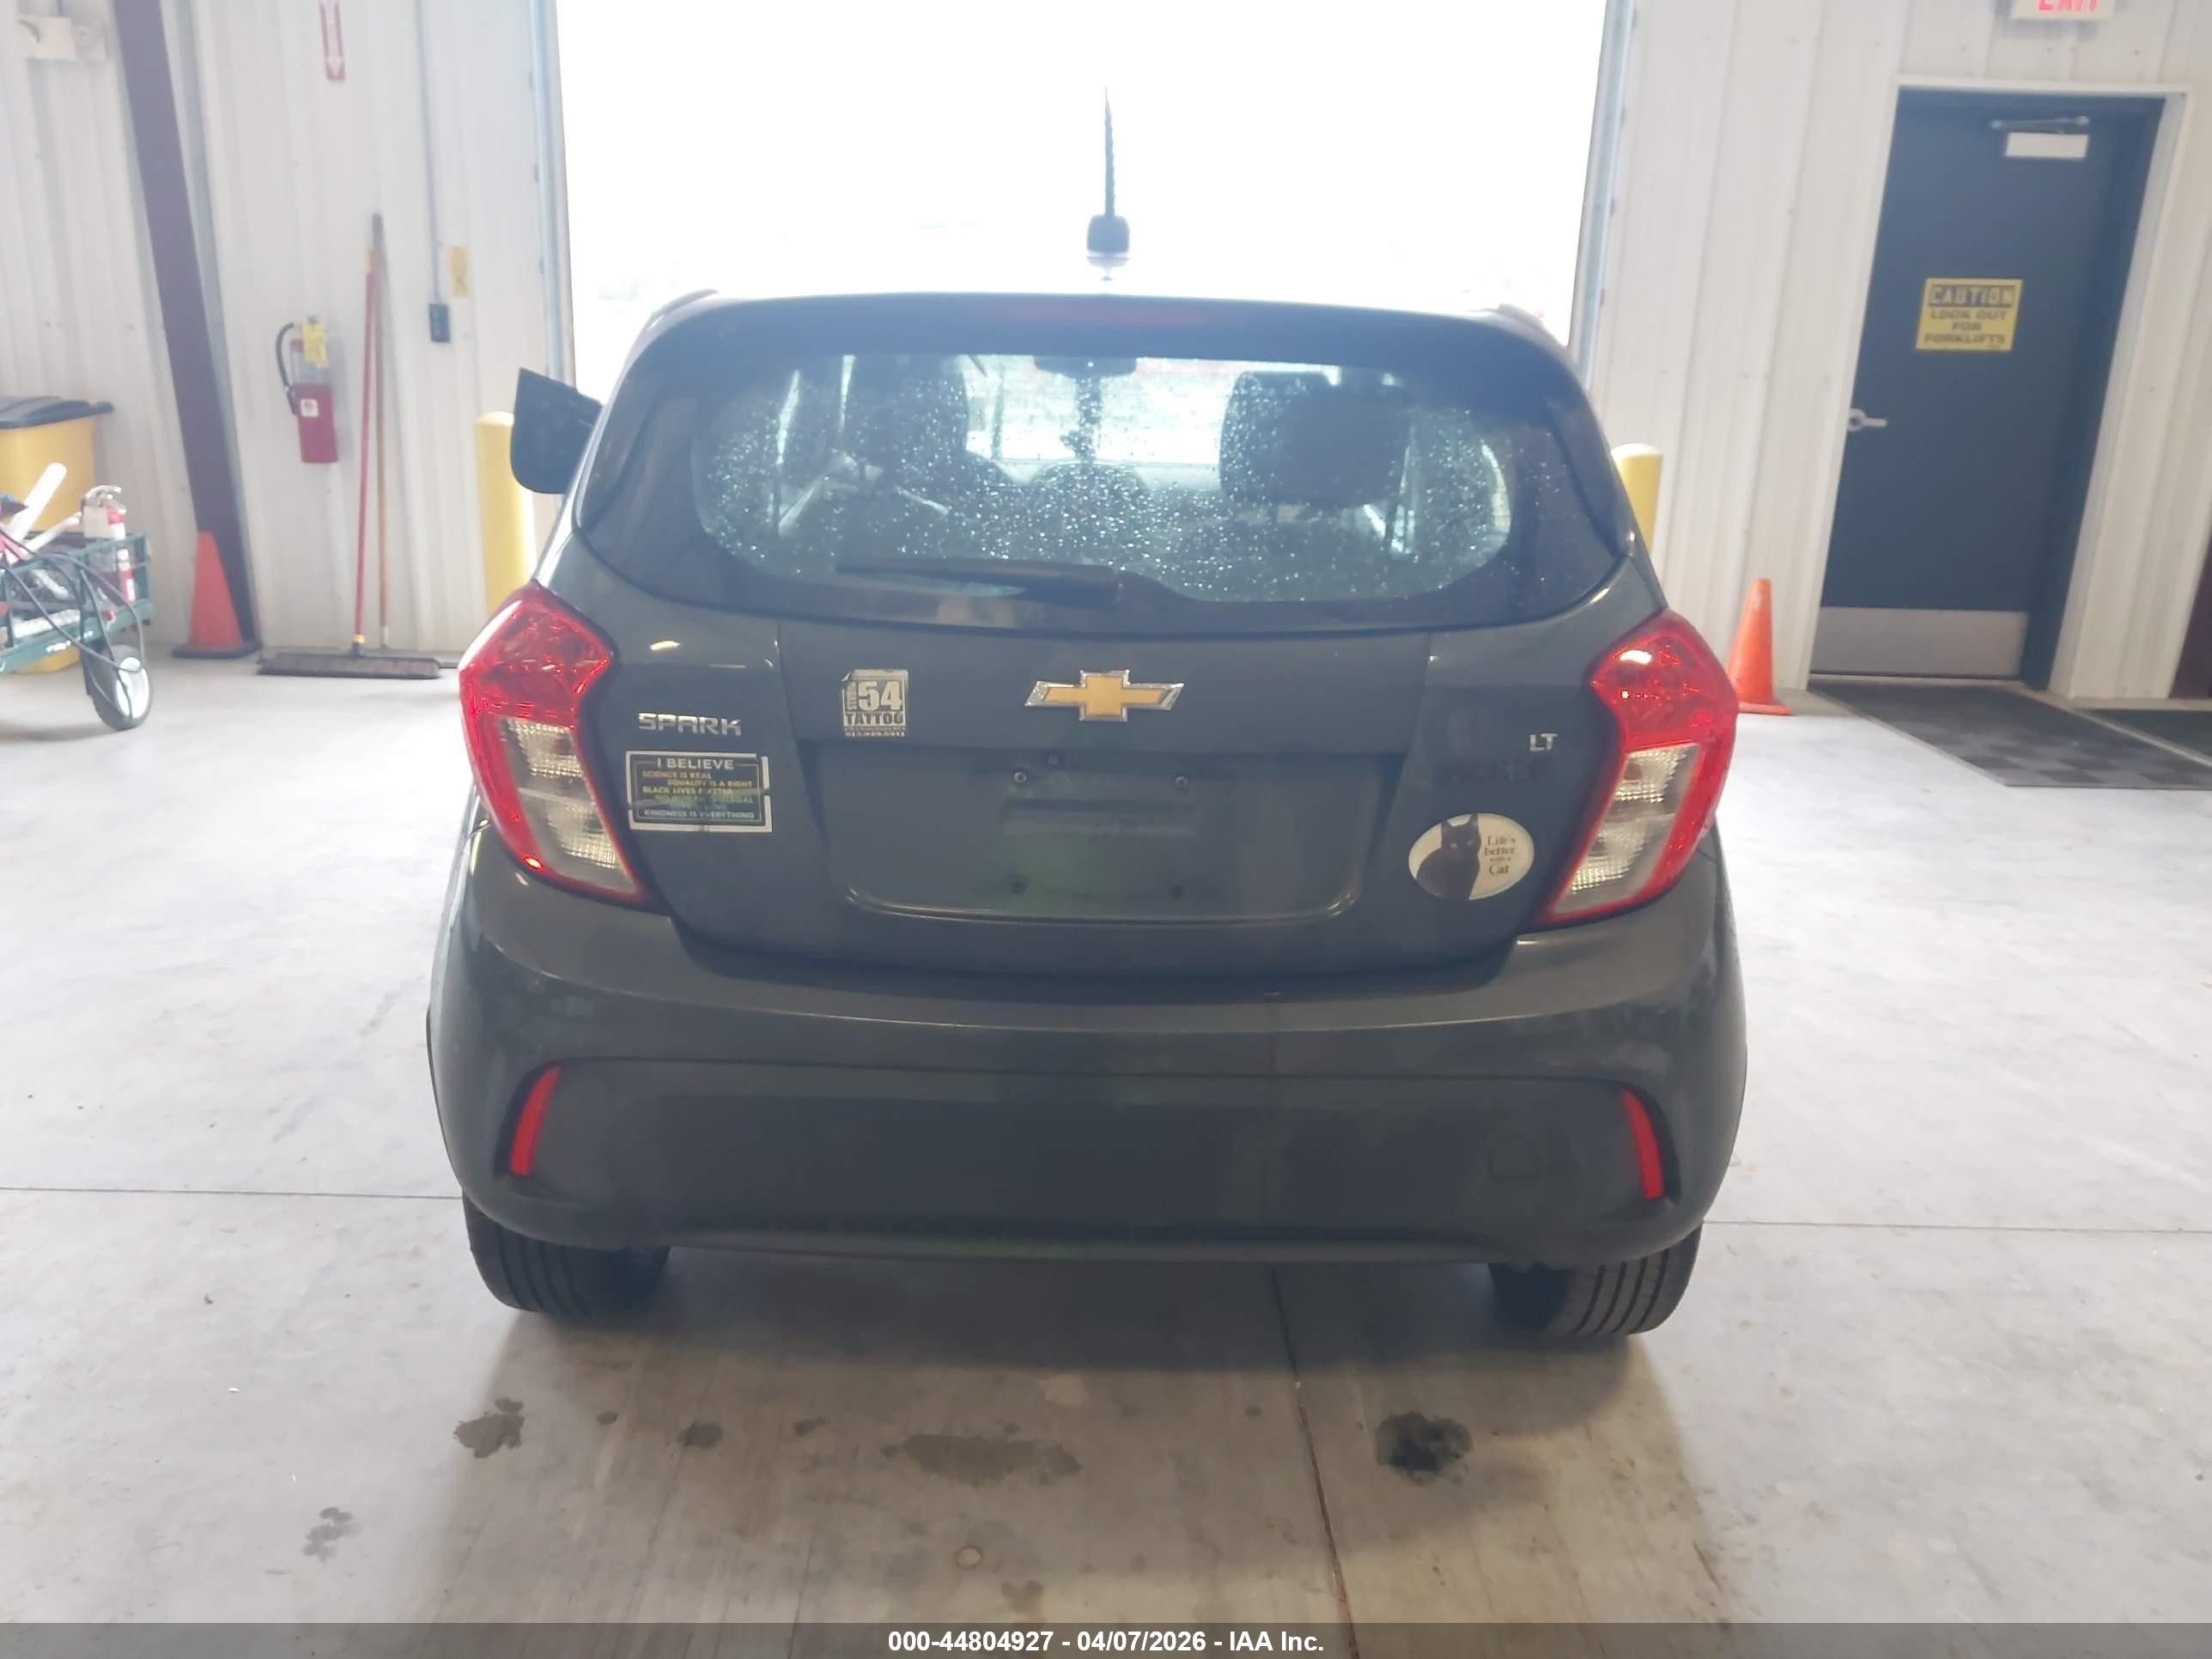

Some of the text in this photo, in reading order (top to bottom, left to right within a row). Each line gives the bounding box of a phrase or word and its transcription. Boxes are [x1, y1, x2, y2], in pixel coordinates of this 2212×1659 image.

[1929, 287, 2014, 305] CAUTION
[1930, 309, 2008, 319] LOOK OUT
[1952, 321, 1982, 331] FOR
[1923, 333, 2006, 343] FORKLIFTS
[858, 680, 902, 711] 54
[638, 712, 741, 736] SPARK
[1529, 733, 1559, 751] LT
[657, 757, 735, 770] I BELIEVE
[1489, 865, 1510, 875] Cat
